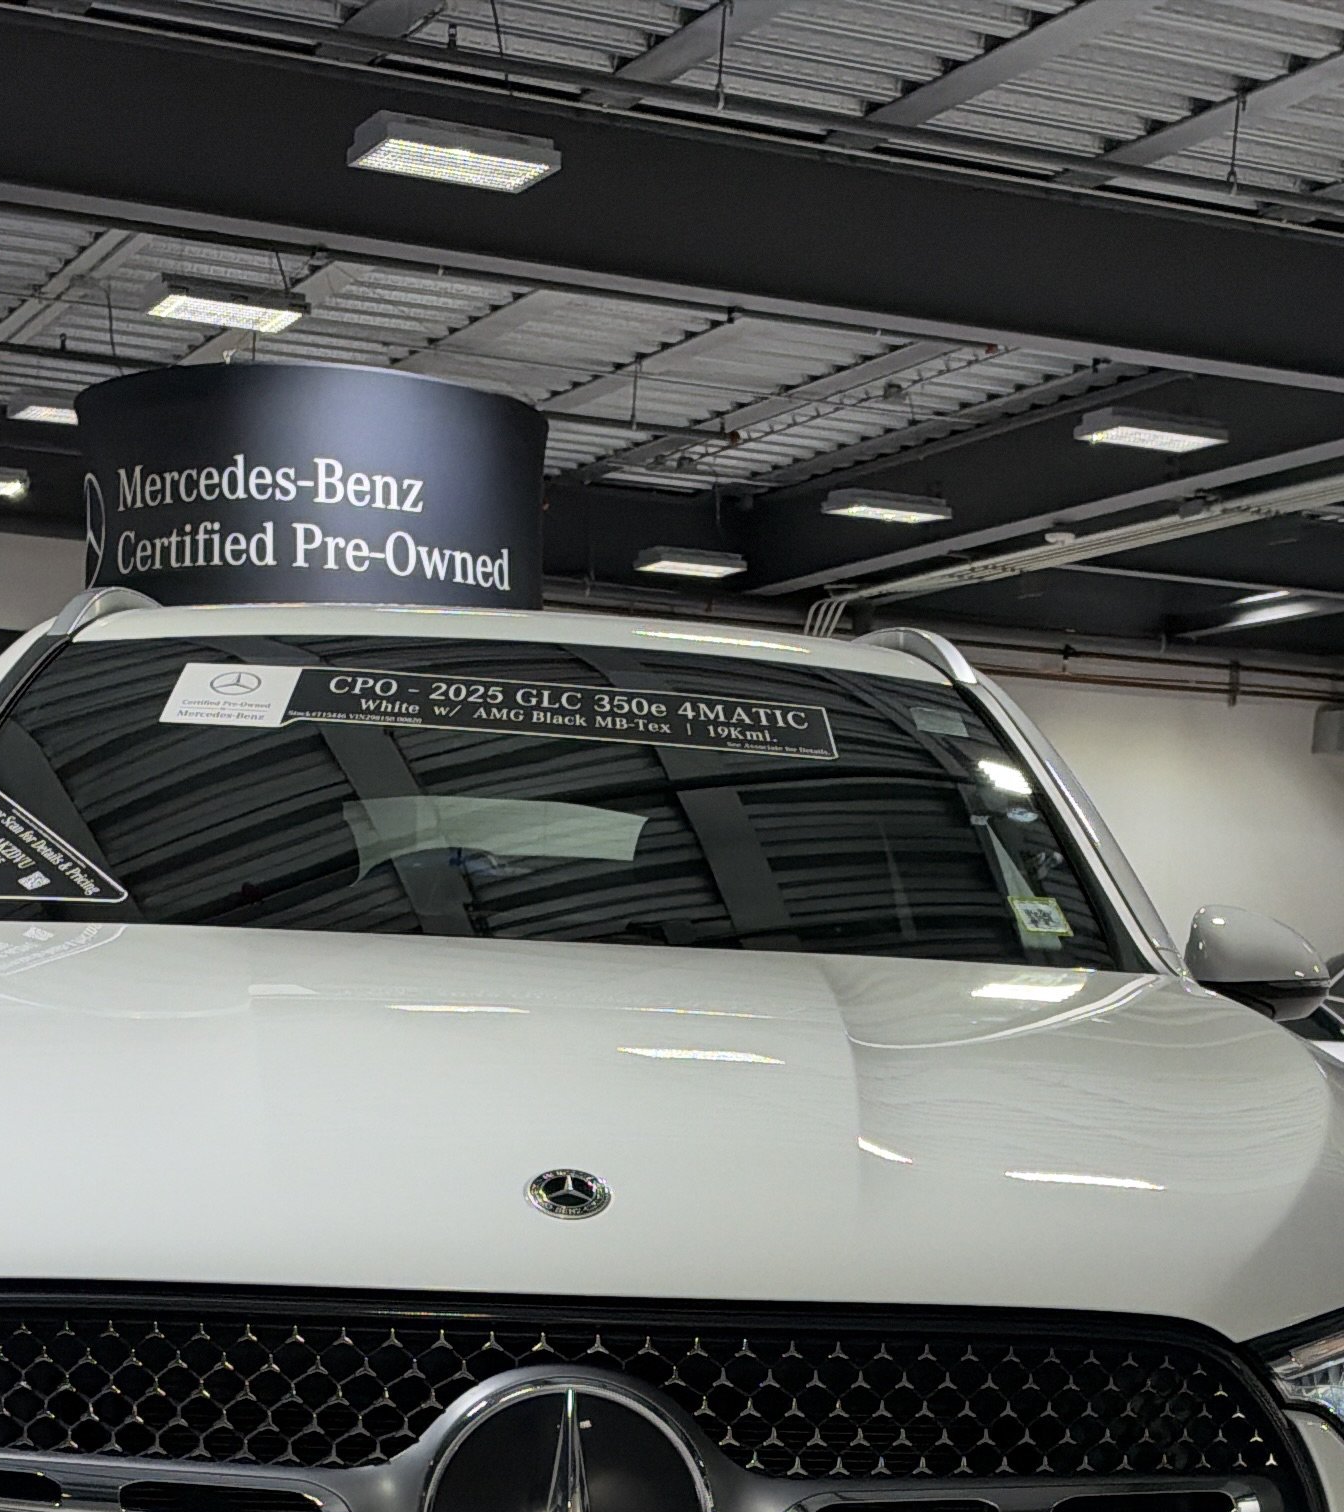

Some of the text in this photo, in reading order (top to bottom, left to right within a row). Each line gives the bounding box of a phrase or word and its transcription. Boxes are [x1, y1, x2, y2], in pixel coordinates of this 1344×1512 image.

[117, 454, 425, 514] Mercedes-Benz
[117, 521, 511, 592] Certified Pre-Owned
[176, 709, 265, 721] Mercedes-Benz
[222, 701, 271, 709] Pre-Owned
[329, 675, 398, 697] CPO
[428, 682, 505, 704] 2025
[515, 687, 583, 710] GLC
[594, 694, 667, 717] 350e
[677, 702, 809, 730] 4MATIC
[360, 698, 420, 714] White
[433, 704, 462, 718] w/
[472, 706, 525, 722] AMG
[531, 709, 588, 727] Black
[595, 715, 672, 734] MB-Tex
[0, 815, 25, 834] Scan
[19, 830, 38, 843] for
[31, 839, 65, 866] Details
[58, 861, 73, 871] &
[65, 867, 101, 896] Pricing
